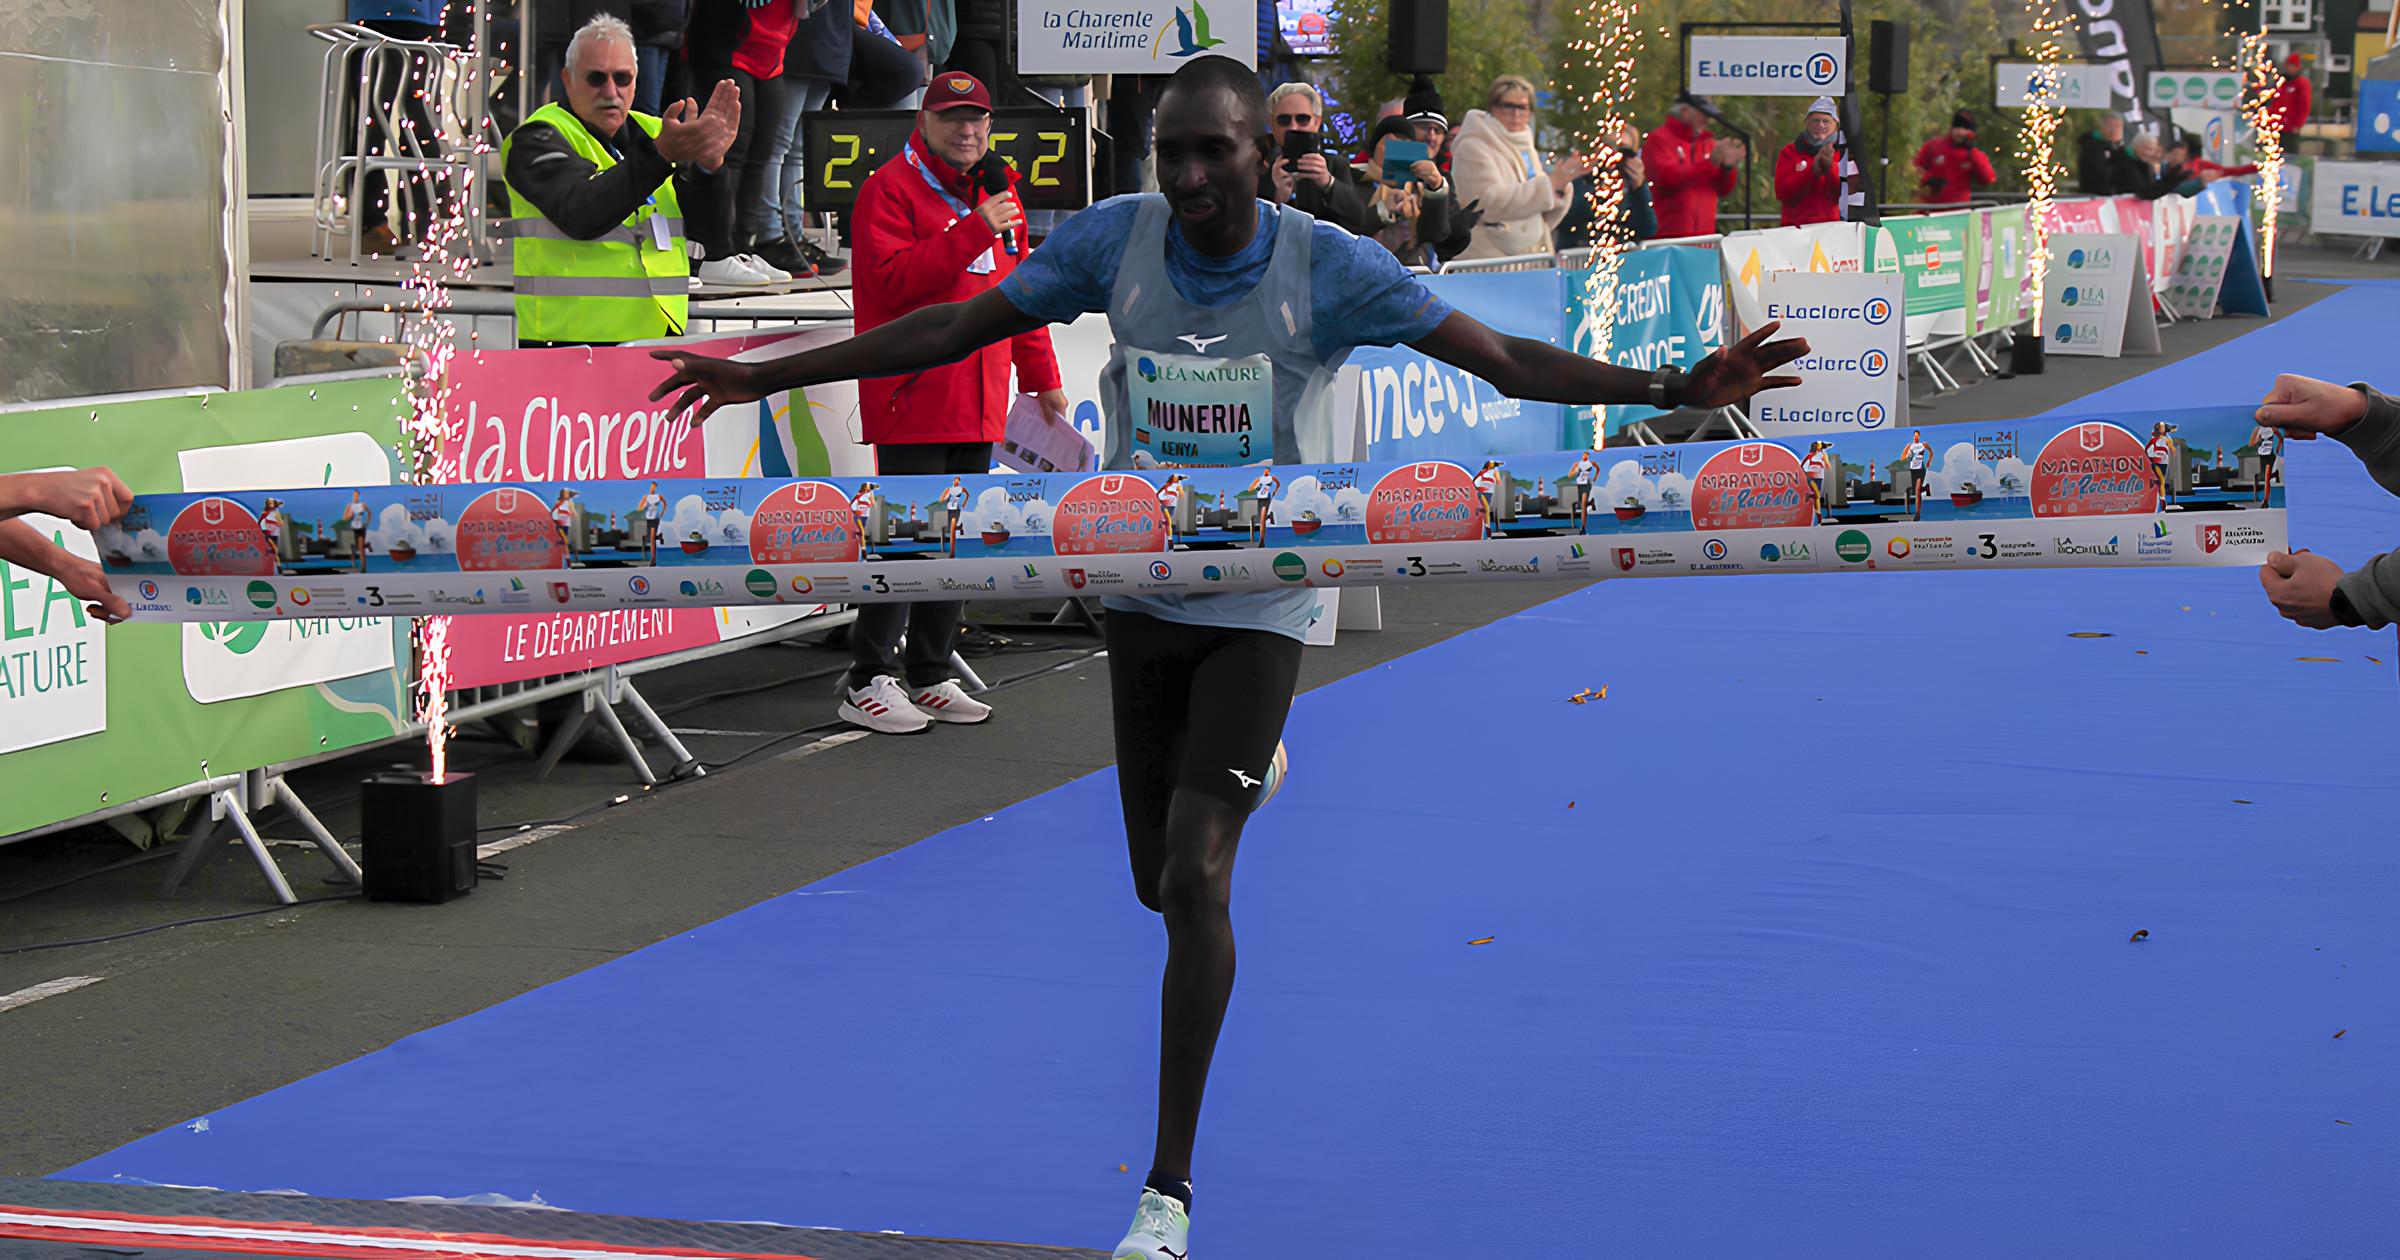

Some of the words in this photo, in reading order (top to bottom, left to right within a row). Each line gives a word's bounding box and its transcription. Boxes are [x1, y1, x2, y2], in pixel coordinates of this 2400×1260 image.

[1043, 10, 1061, 28] la
[1066, 9, 1153, 28] Charente
[1062, 31, 1148, 49] Maritime
[1698, 60, 1803, 78] E.Leclerc
[1616, 269, 1671, 326] CRÉDIT
[1192, 366, 1262, 383] NATURE
[1147, 396, 1253, 434] MUNERIA
[1238, 433, 1250, 459] 3
[2041, 455, 2145, 476] MARATHON
[503, 623, 528, 663] LE
[533, 608, 674, 659] DÉPARTEMENT
